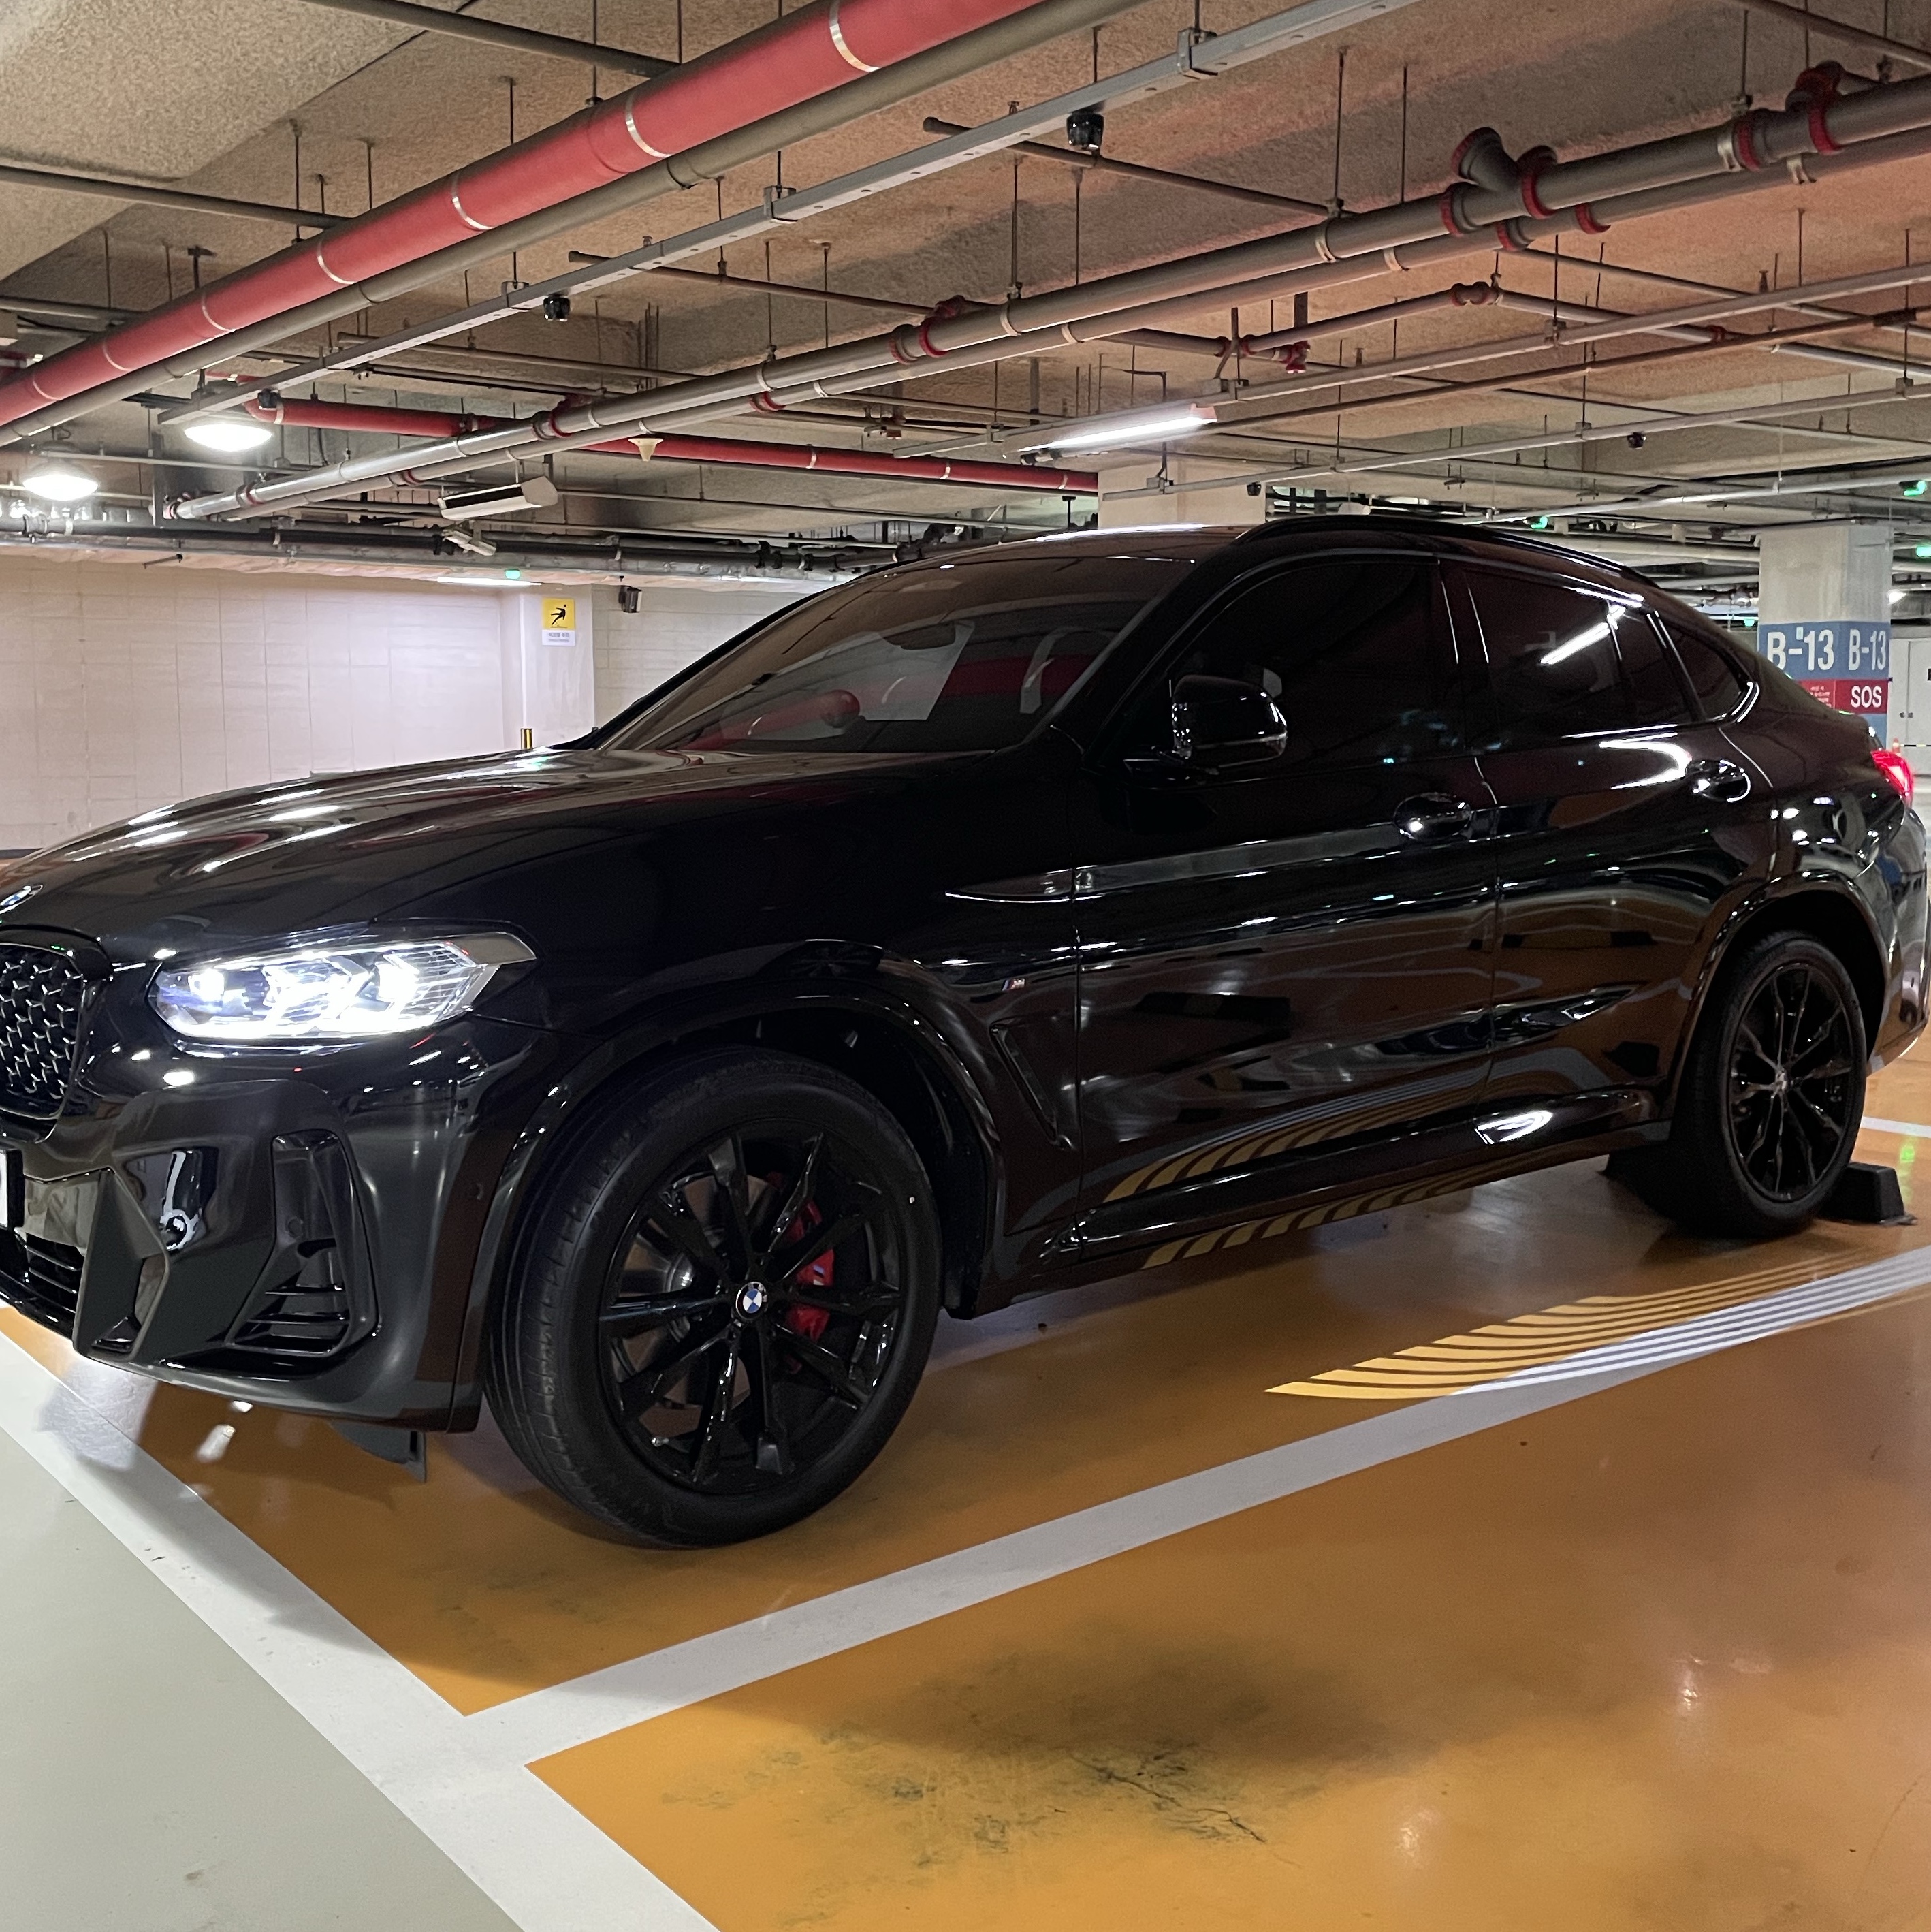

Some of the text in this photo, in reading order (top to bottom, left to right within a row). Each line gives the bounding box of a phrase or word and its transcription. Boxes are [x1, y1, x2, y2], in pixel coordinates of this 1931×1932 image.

[1767, 629, 1834, 671] B-13
[1849, 629, 1886, 671] B-13
[1851, 686, 1882, 708] SOS
